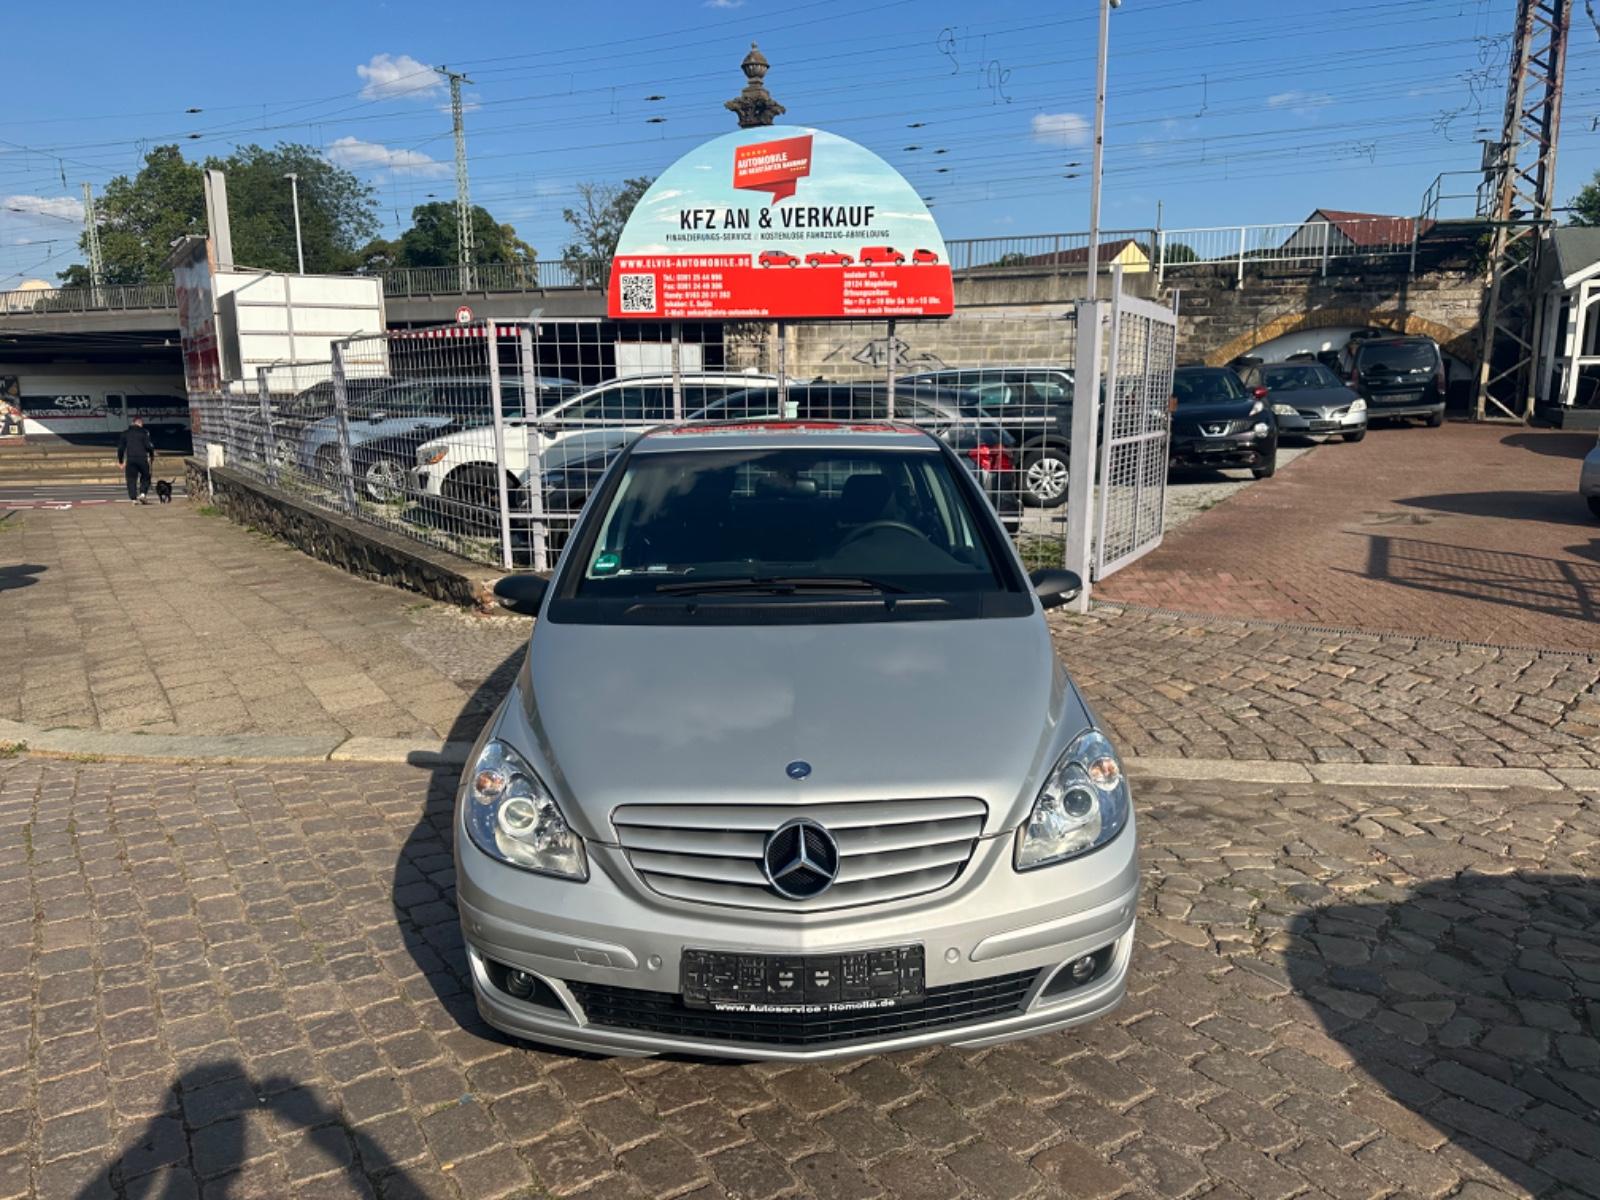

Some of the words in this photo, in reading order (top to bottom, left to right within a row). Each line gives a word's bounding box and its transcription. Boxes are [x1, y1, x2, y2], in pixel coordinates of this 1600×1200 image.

[738, 152, 788, 168] AUTOMOBILE
[680, 209, 717, 230] KFZ
[724, 208, 750, 230] AN
[758, 207, 773, 228] &
[780, 205, 876, 228] VERKAUF
[666, 232, 752, 243] FINANZIERUNGS-SERVICE
[760, 231, 805, 241] KOSTENLOSE
[806, 230, 890, 241] FAHRZEUG-ABMELDUNG
[620, 258, 750, 268] WWW.ELVIS-AUTOMOBILE.DE
[715, 1003, 821, 1013] www.Autoservice
[829, 999, 895, 1012] Homolla.de
